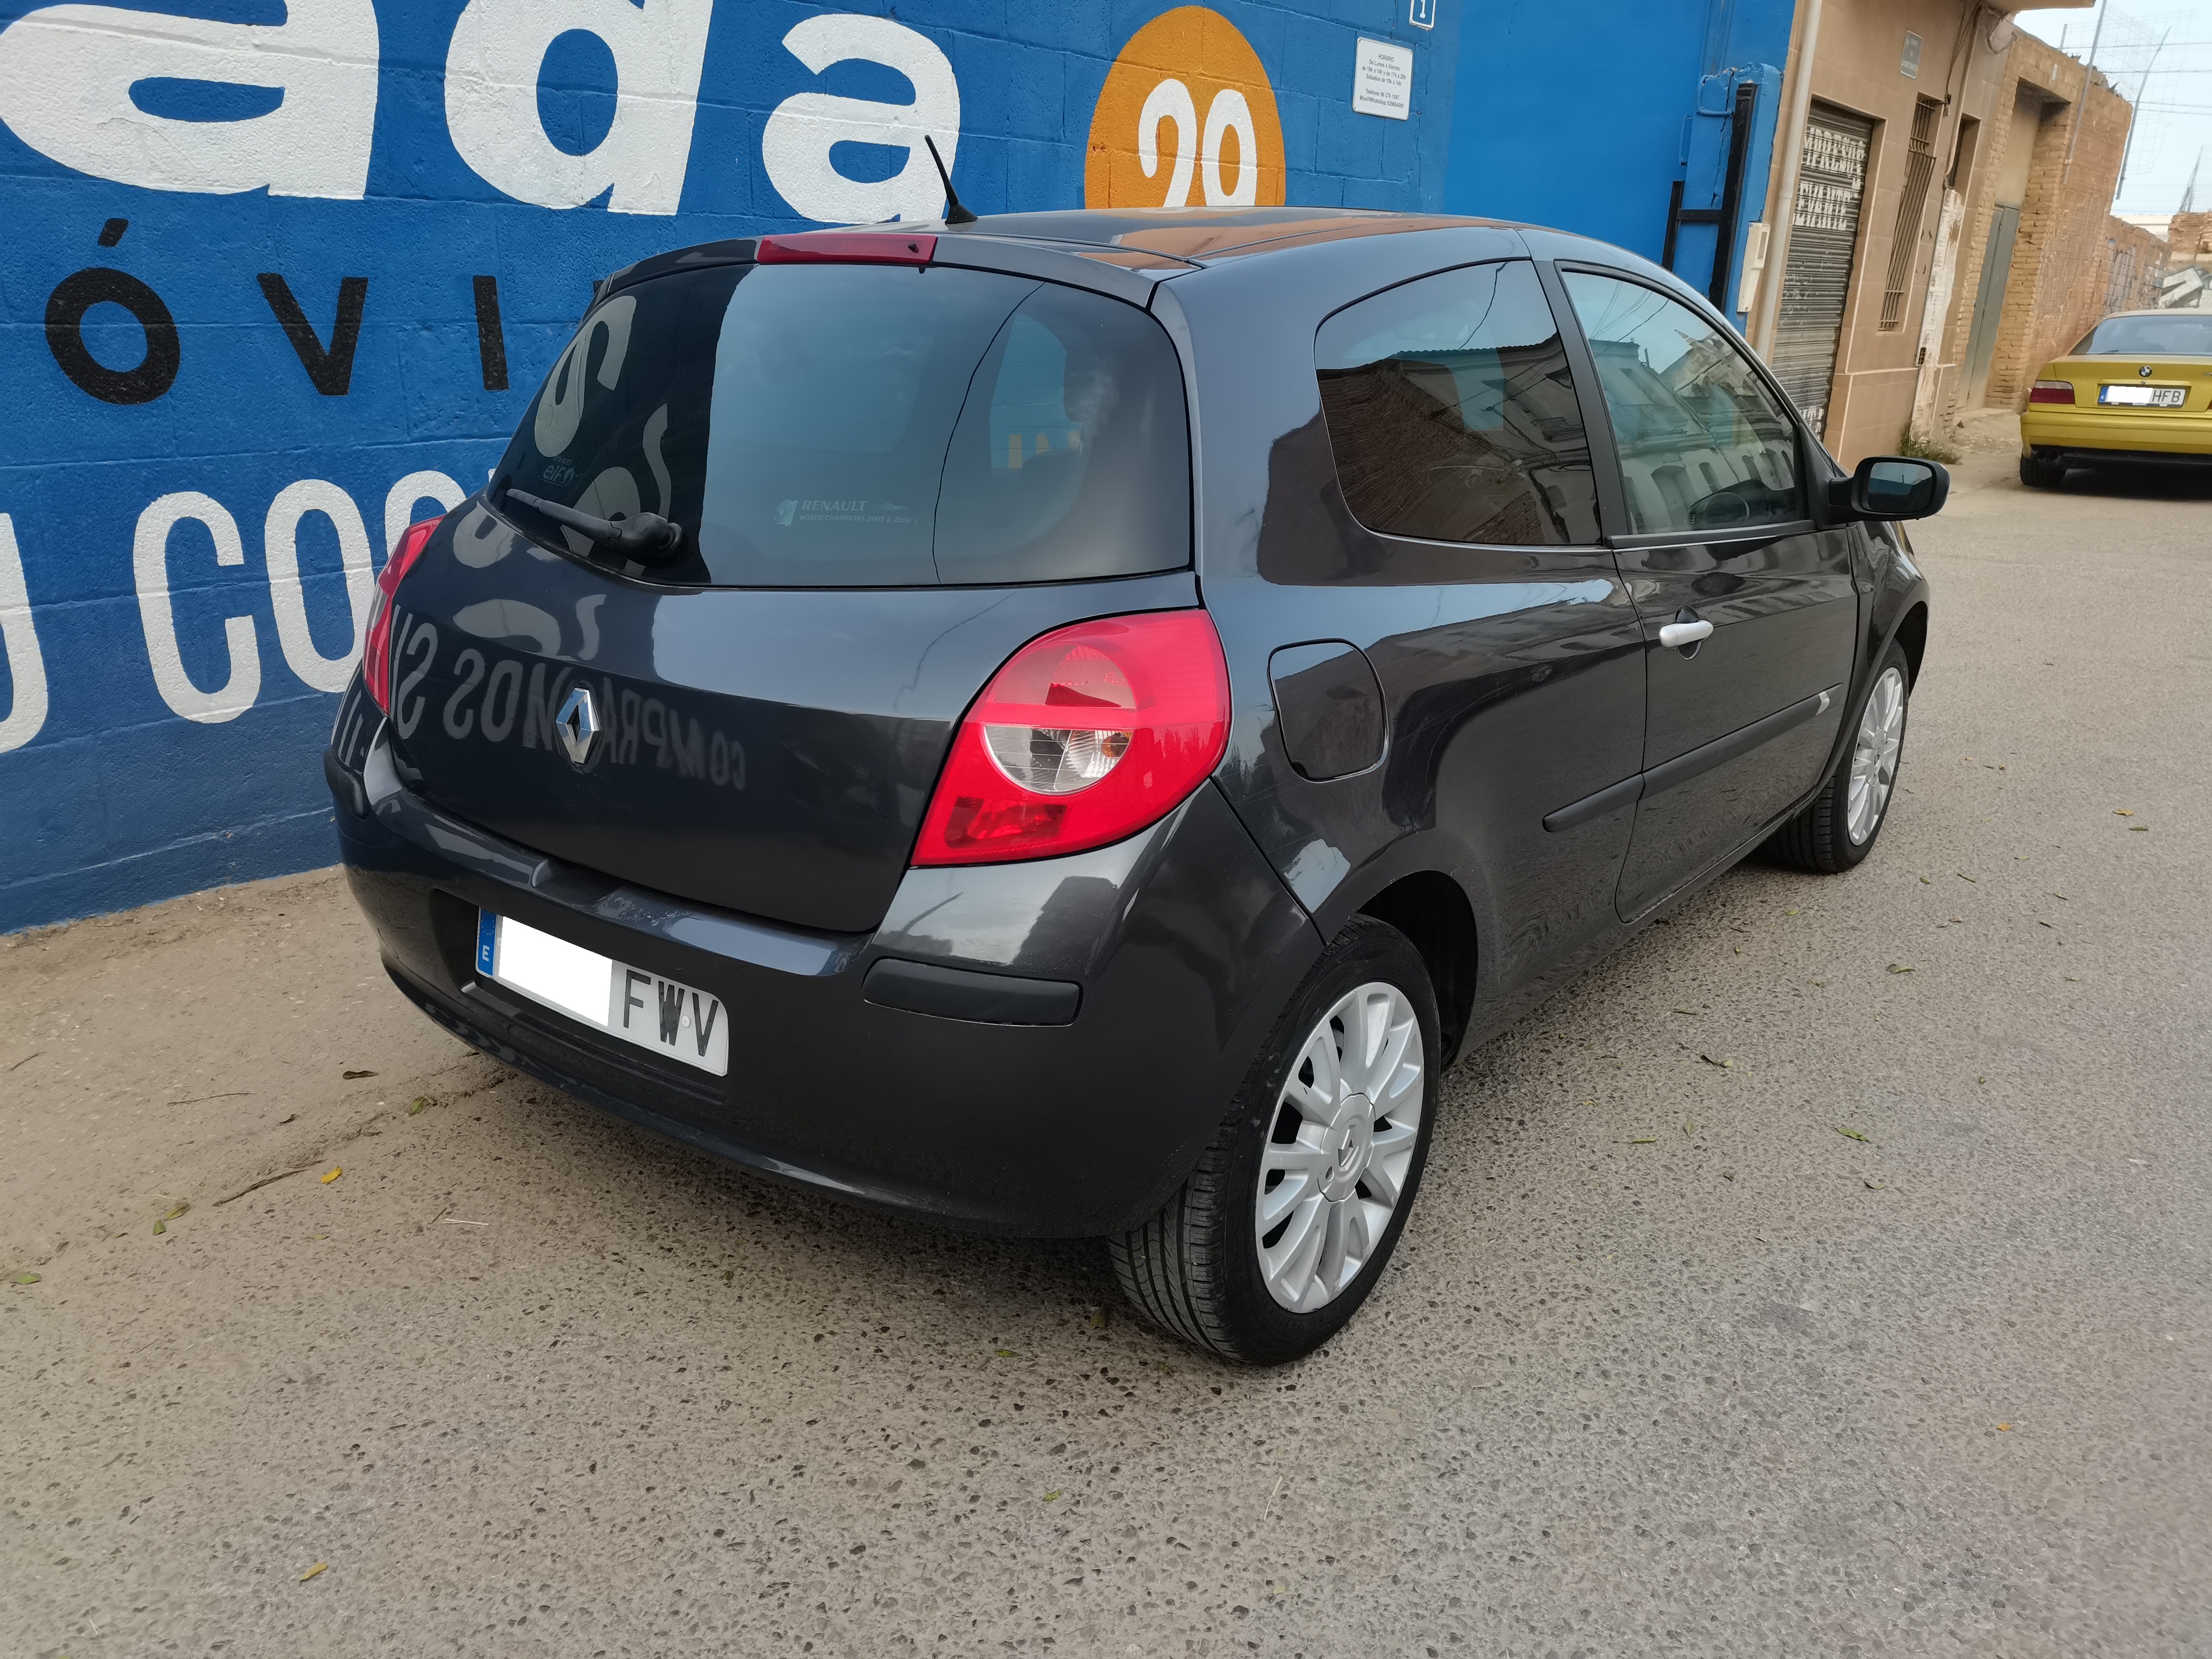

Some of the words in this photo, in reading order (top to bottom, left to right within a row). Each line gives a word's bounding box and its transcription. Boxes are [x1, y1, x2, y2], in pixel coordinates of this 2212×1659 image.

[1378, 54, 1394, 62] HORARIO
[1138, 78, 1257, 206] 90
[44, 218, 604, 406] ÓVI
[2152, 390, 2181, 403] HFB
[802, 500, 868, 511] RENAULT
[133, 468, 496, 723] CO
[481, 944, 490, 962] E
[624, 969, 719, 1058] FWV
